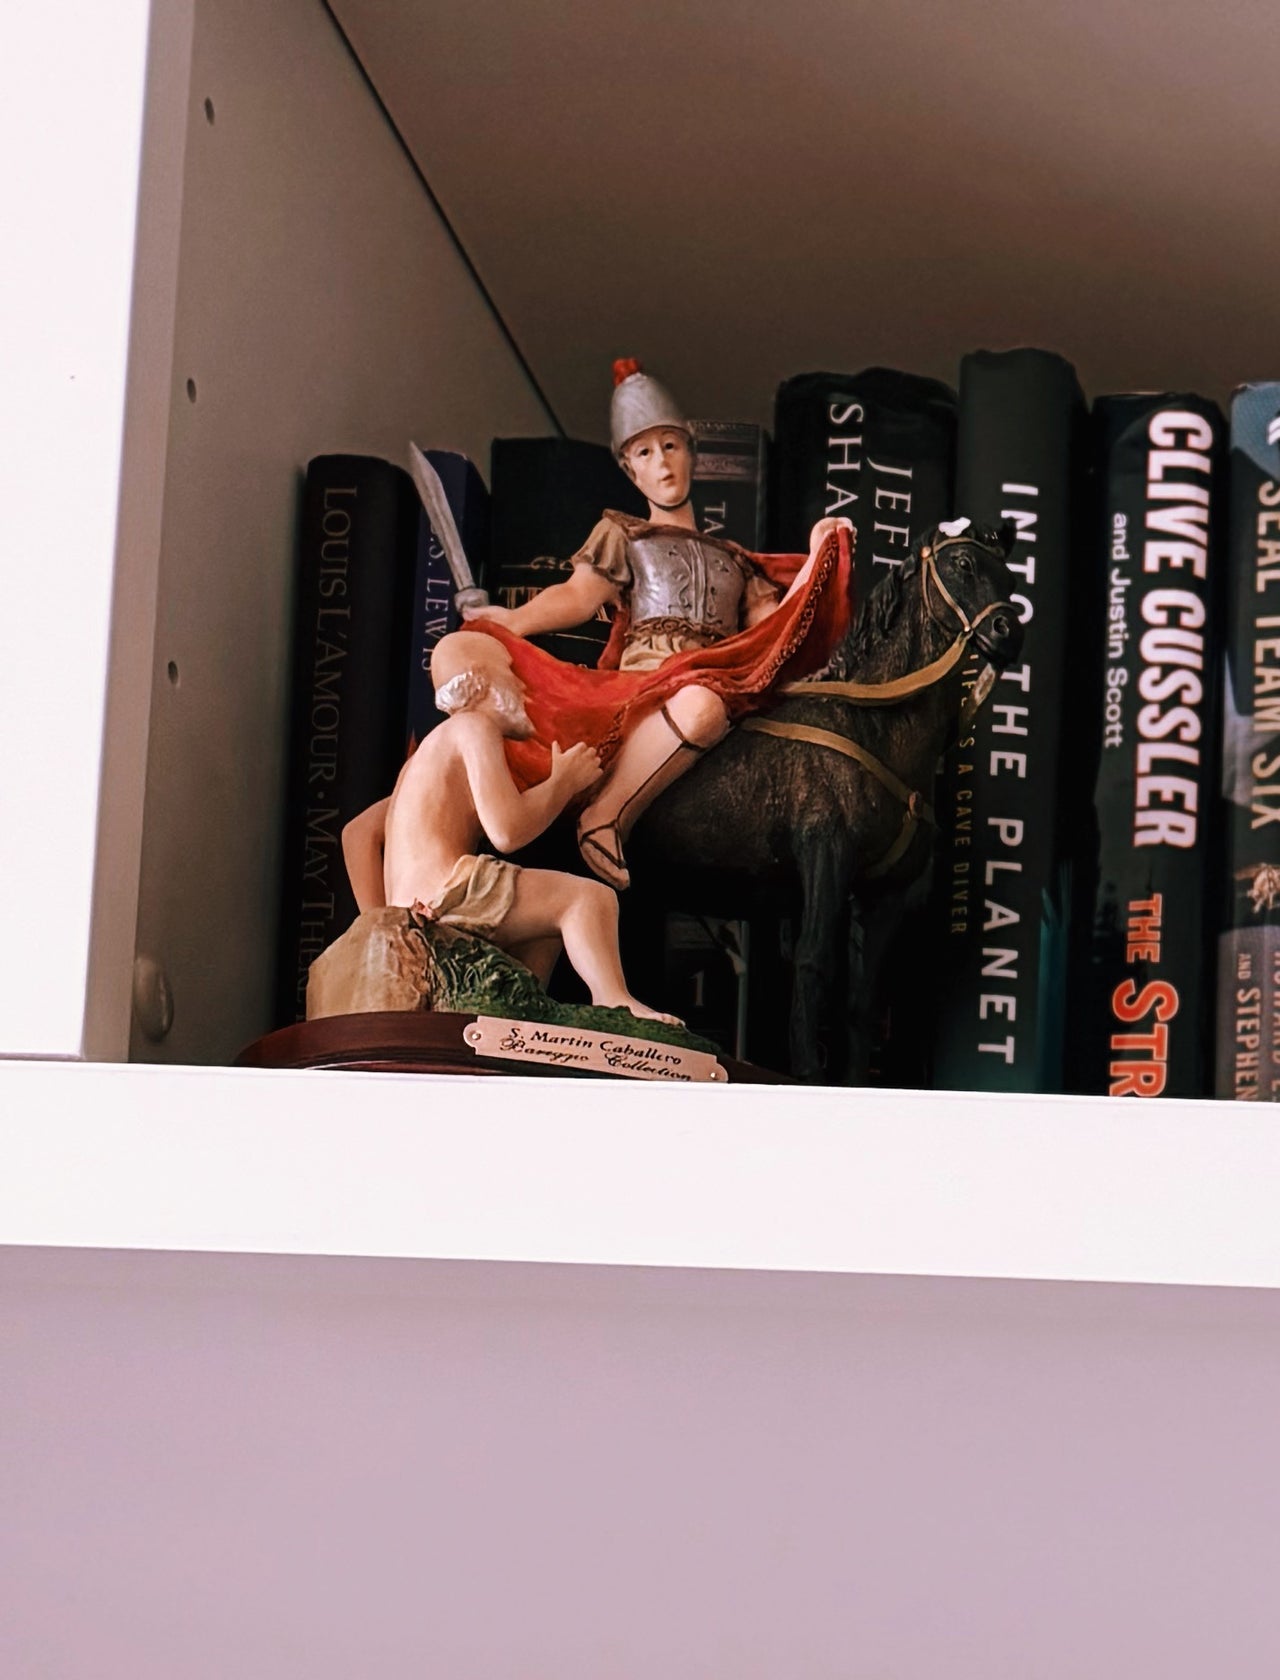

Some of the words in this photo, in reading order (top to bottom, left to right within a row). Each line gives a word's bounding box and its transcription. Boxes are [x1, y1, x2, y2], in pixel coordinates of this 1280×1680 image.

[1111, 512, 1130, 561] and
[1143, 410, 1214, 580] CLIVE
[318, 485, 358, 598] LOUIS
[1108, 568, 1132, 660] Justin
[307, 603, 352, 785] L'AMOUR
[989, 663, 1032, 780] THE
[1104, 667, 1129, 748] Scott
[1134, 588, 1206, 848] CUSSLER
[301, 804, 341, 890] MAY
[953, 788, 974, 848] CAVE
[950, 861, 970, 935] DIVER
[977, 815, 1026, 1066] PLANET
[1126, 892, 1163, 964] THE
[1237, 953, 1252, 980] AND
[530, 1030, 593, 1049] Martin
[599, 1040, 683, 1066] Caballero
[604, 1051, 692, 1081] Collection
[1109, 978, 1180, 1098] STR
[1235, 987, 1262, 1100] STEPHEN
